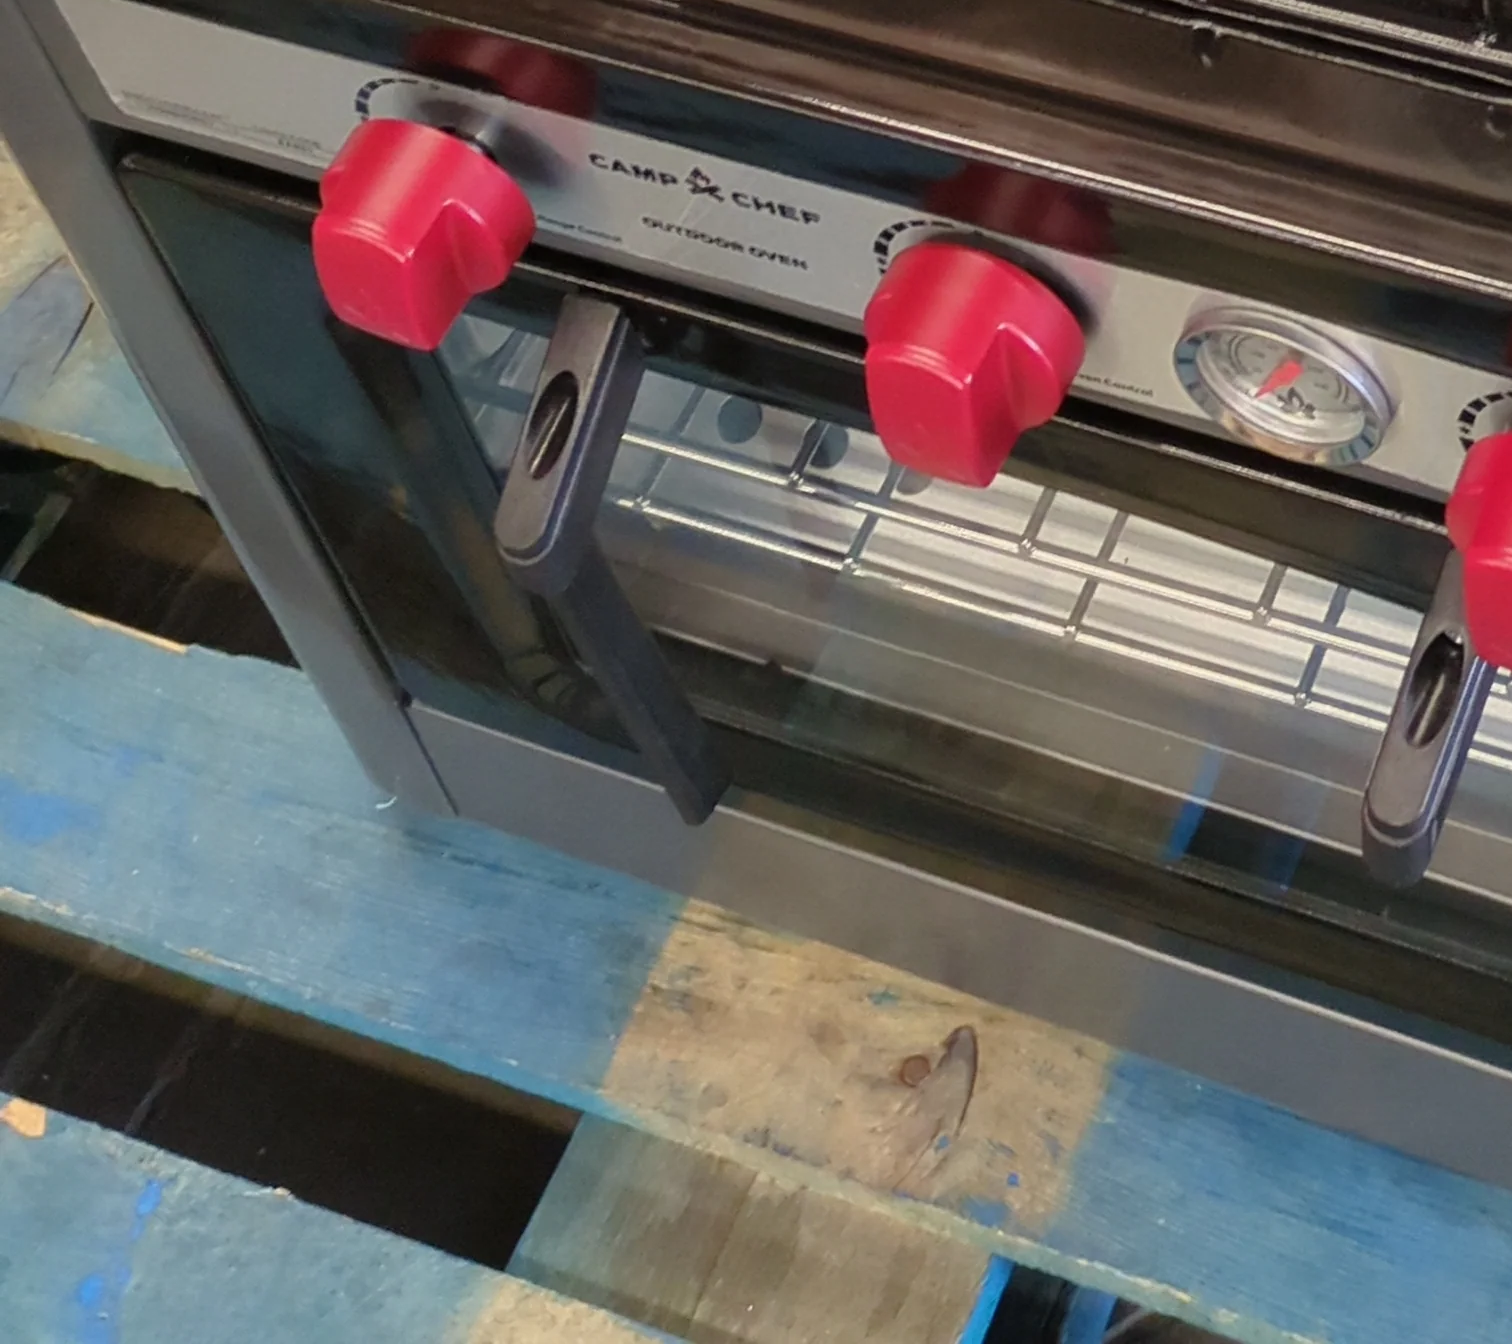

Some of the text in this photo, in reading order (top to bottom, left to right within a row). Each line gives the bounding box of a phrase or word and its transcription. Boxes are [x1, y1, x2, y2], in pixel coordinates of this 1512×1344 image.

[588, 152, 822, 225] CAMP CHEF
[642, 215, 809, 271] OUTDOOR OVEN
